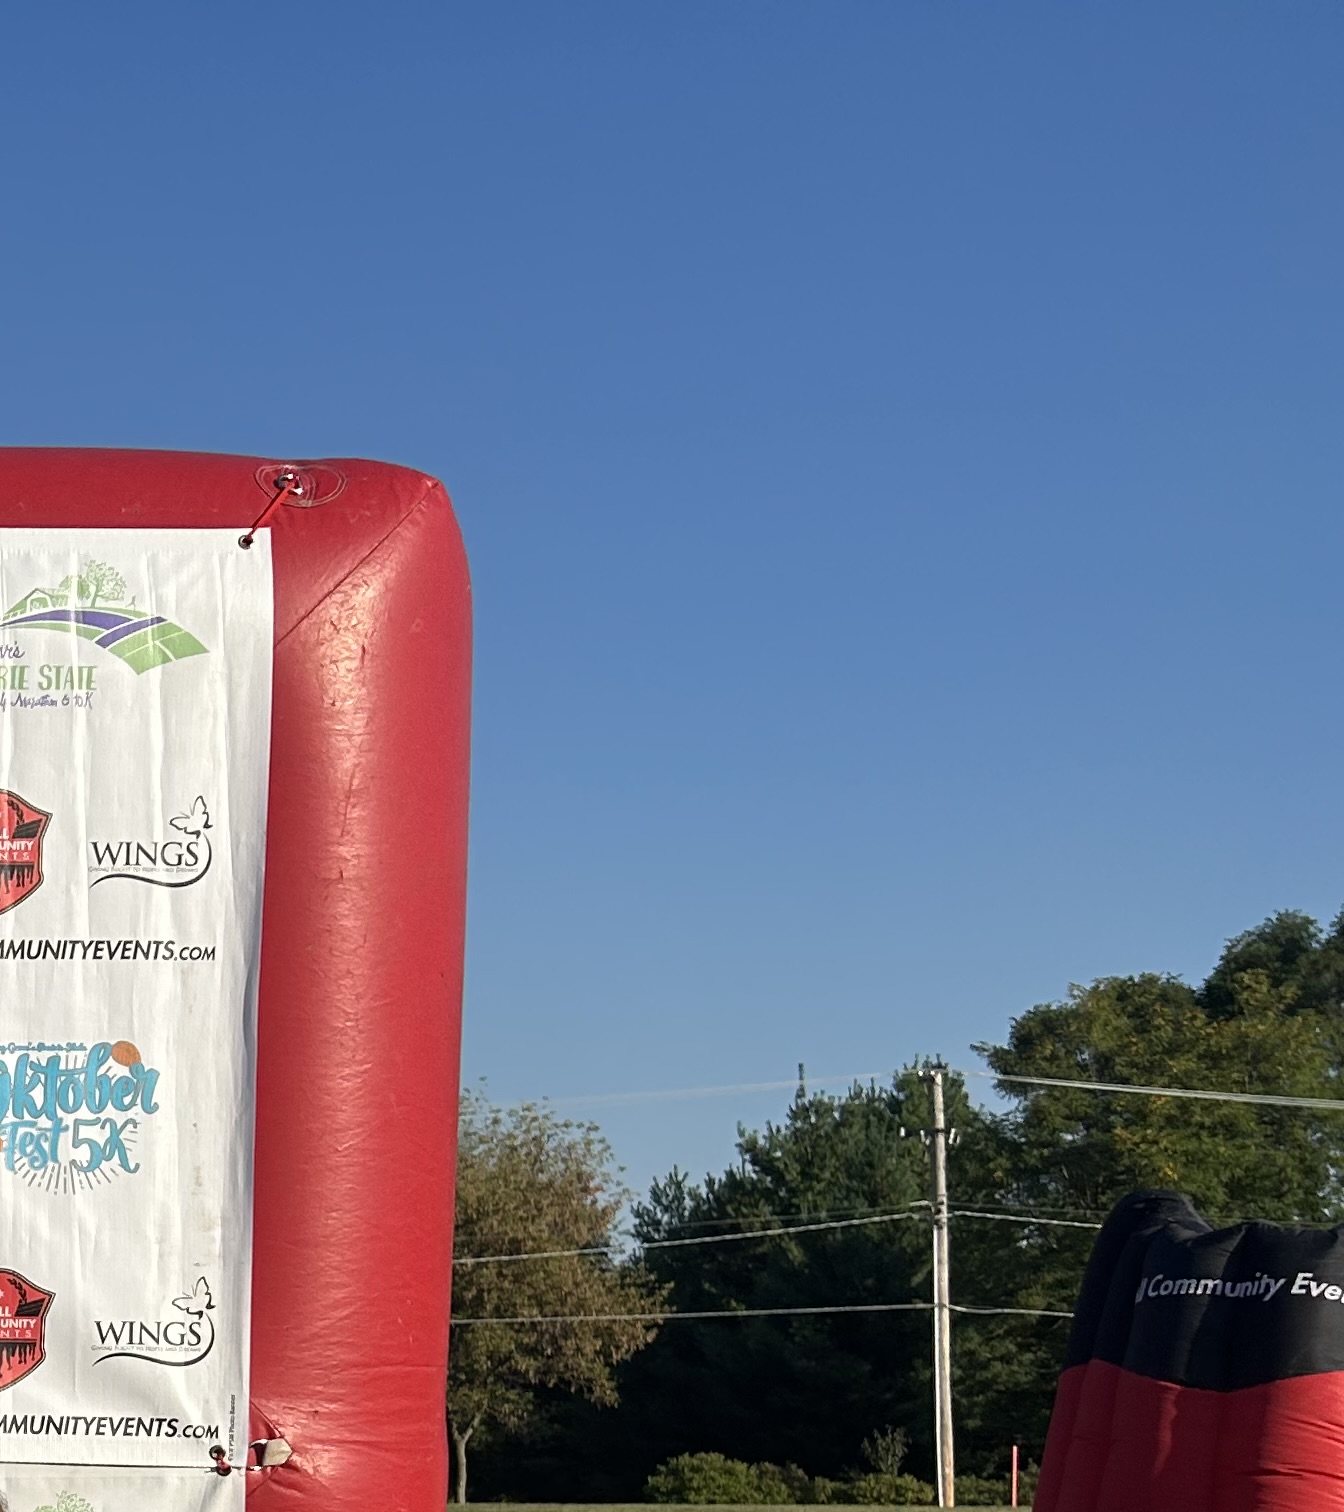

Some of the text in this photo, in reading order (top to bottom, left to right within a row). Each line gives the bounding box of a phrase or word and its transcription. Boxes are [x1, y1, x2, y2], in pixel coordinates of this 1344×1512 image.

[38, 664, 98, 691] STATE
[91, 840, 199, 867] WINGS
[71, 1117, 141, 1174] 5K
[1148, 1272, 1344, 1305] Community Eve
[94, 1320, 202, 1346] WINGS
